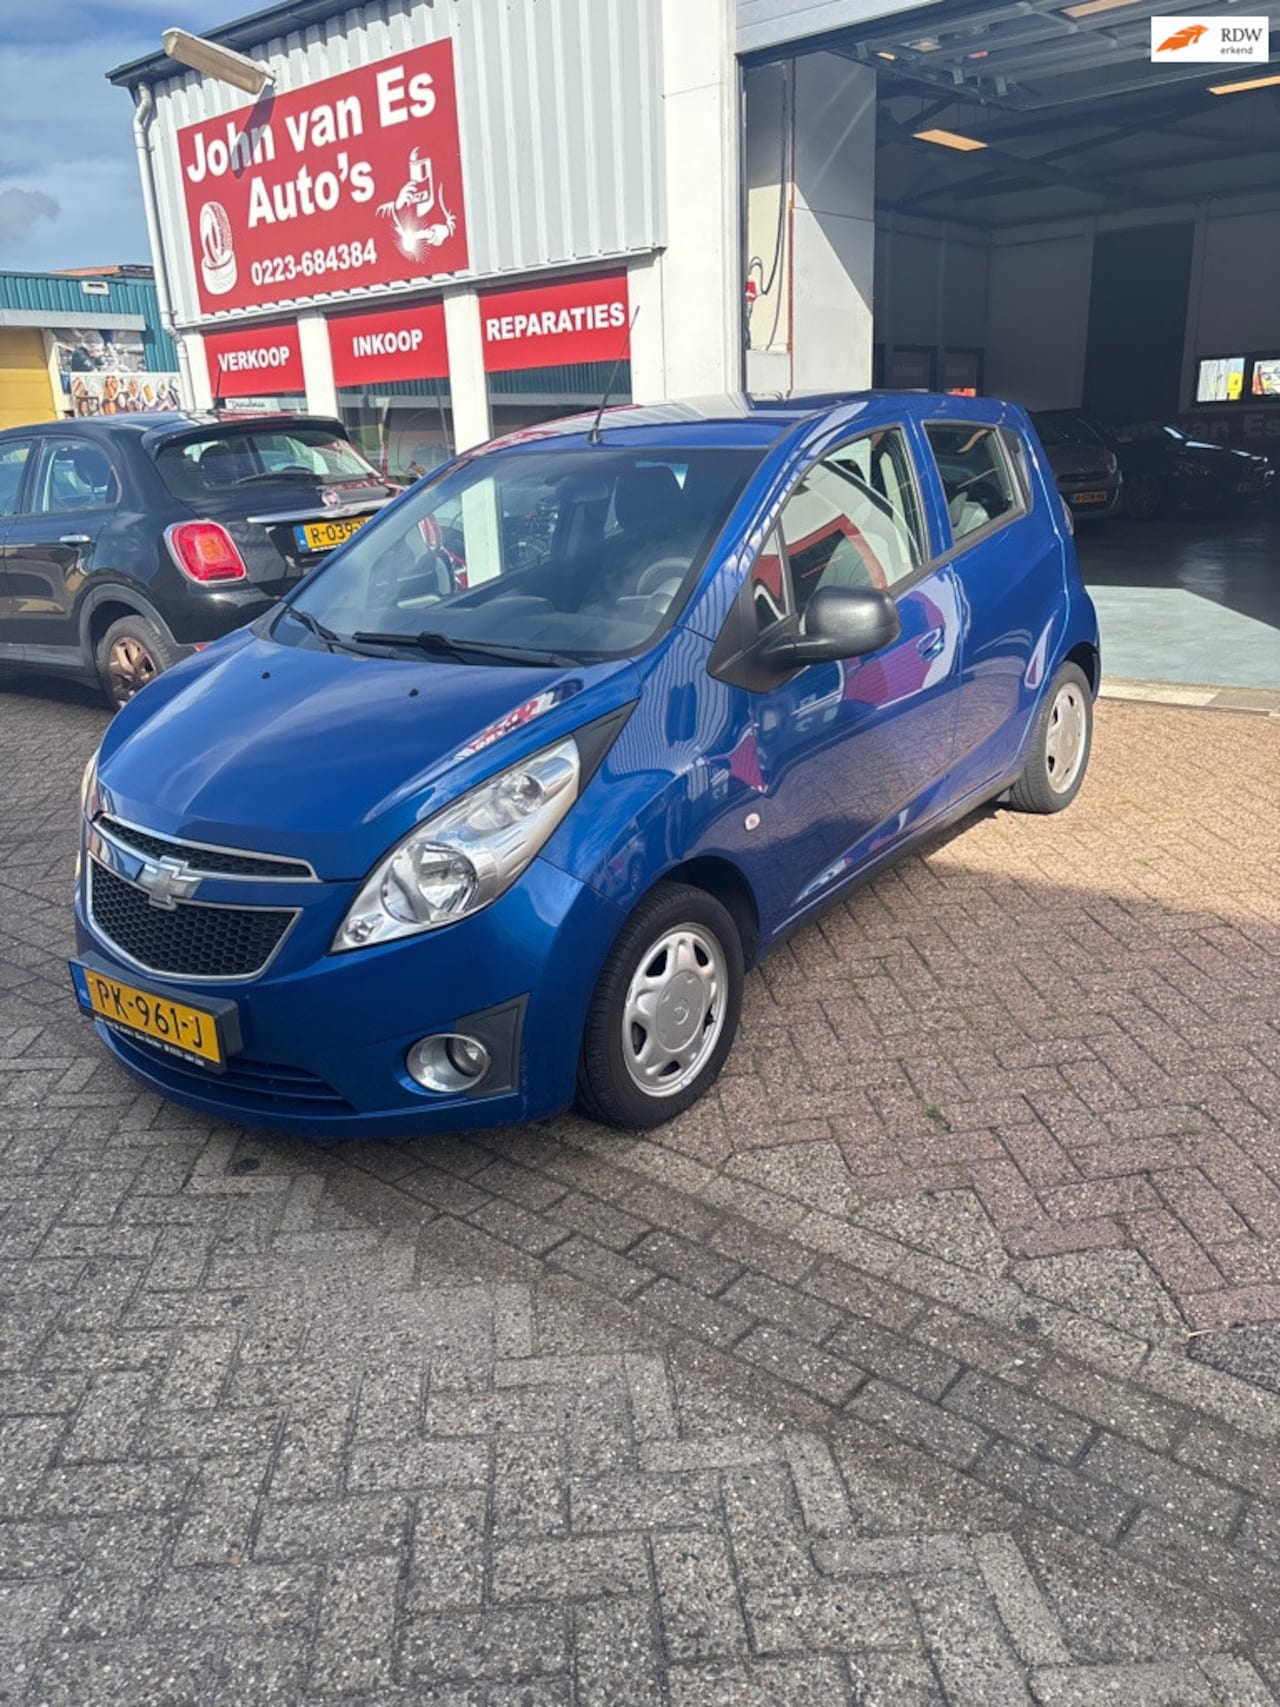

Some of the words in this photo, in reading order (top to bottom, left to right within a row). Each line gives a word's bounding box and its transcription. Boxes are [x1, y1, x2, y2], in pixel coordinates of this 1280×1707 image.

[186, 121, 276, 183] John
[285, 94, 364, 153] van
[376, 65, 437, 128] Es
[248, 152, 375, 229] Auto's
[251, 238, 378, 286] 0223-684384
[352, 328, 424, 358] INKOOP
[486, 301, 626, 341] REPARATIES
[218, 345, 290, 373] VERKOOP
[95, 978, 203, 1049] PK-961-J
